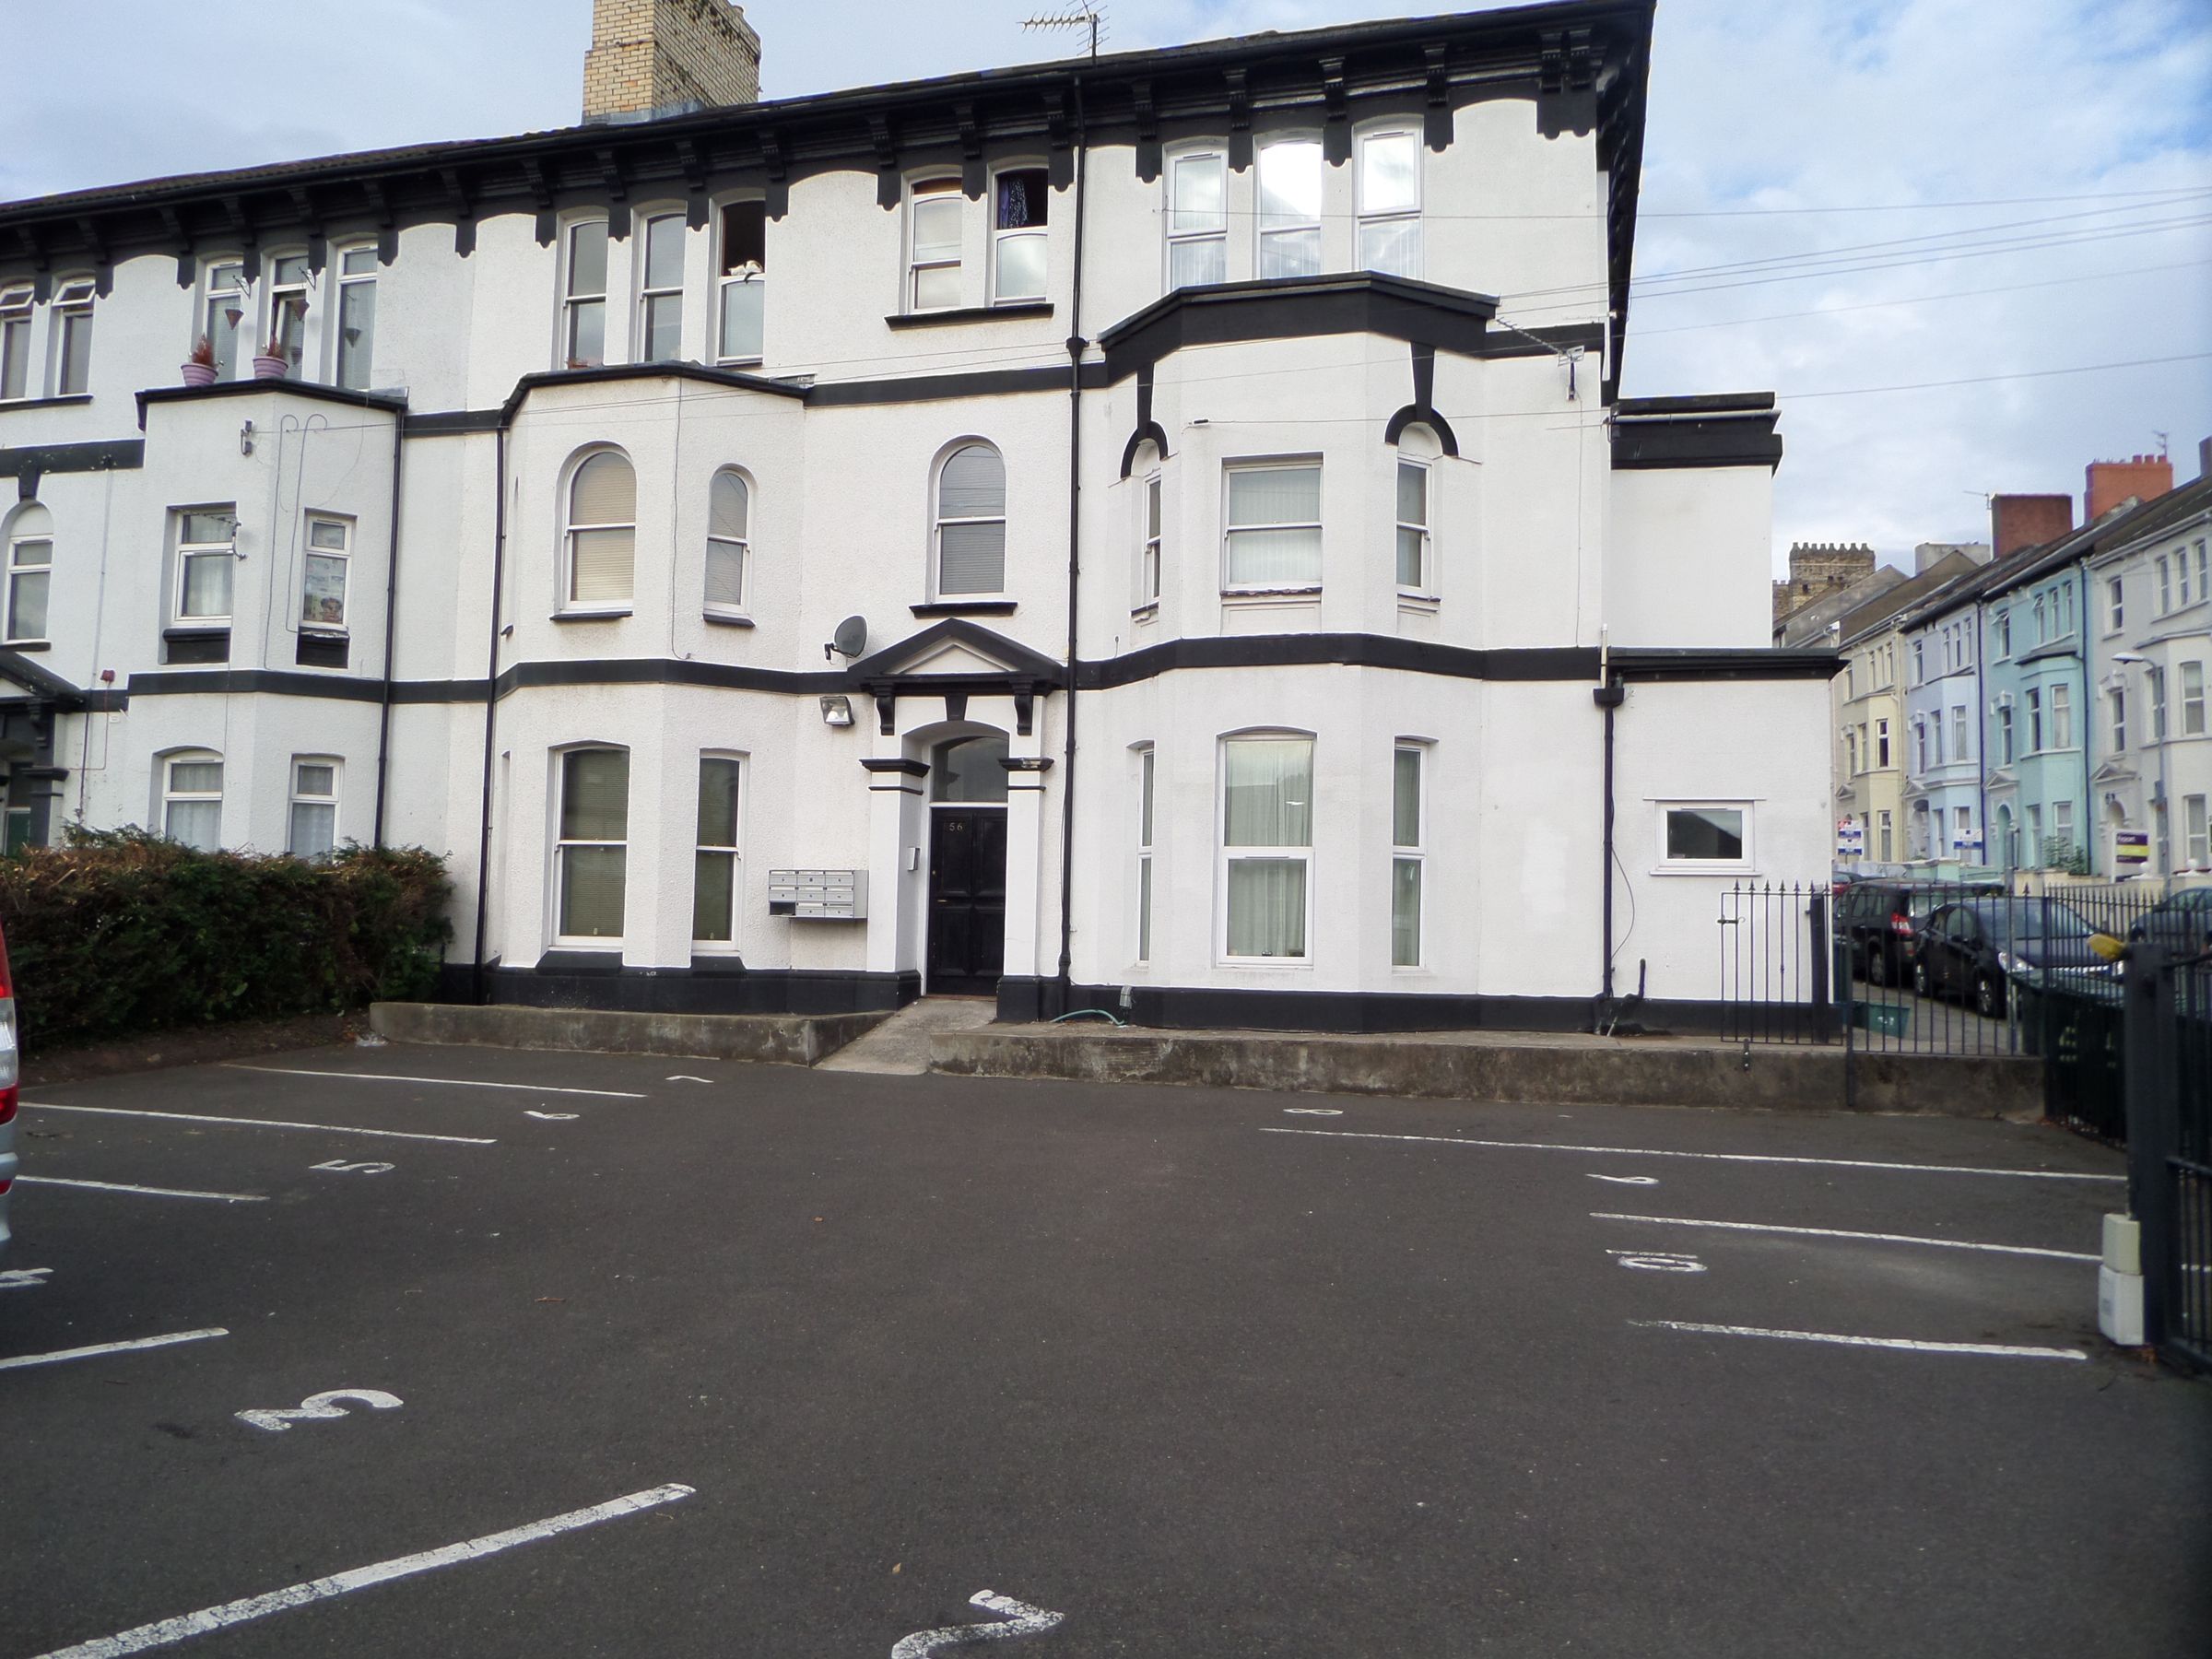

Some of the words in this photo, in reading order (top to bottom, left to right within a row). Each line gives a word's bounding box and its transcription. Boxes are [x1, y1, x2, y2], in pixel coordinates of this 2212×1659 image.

[949, 822, 963, 831] 56
[309, 1159, 395, 1174] 5
[1605, 1248, 1708, 1273] 10
